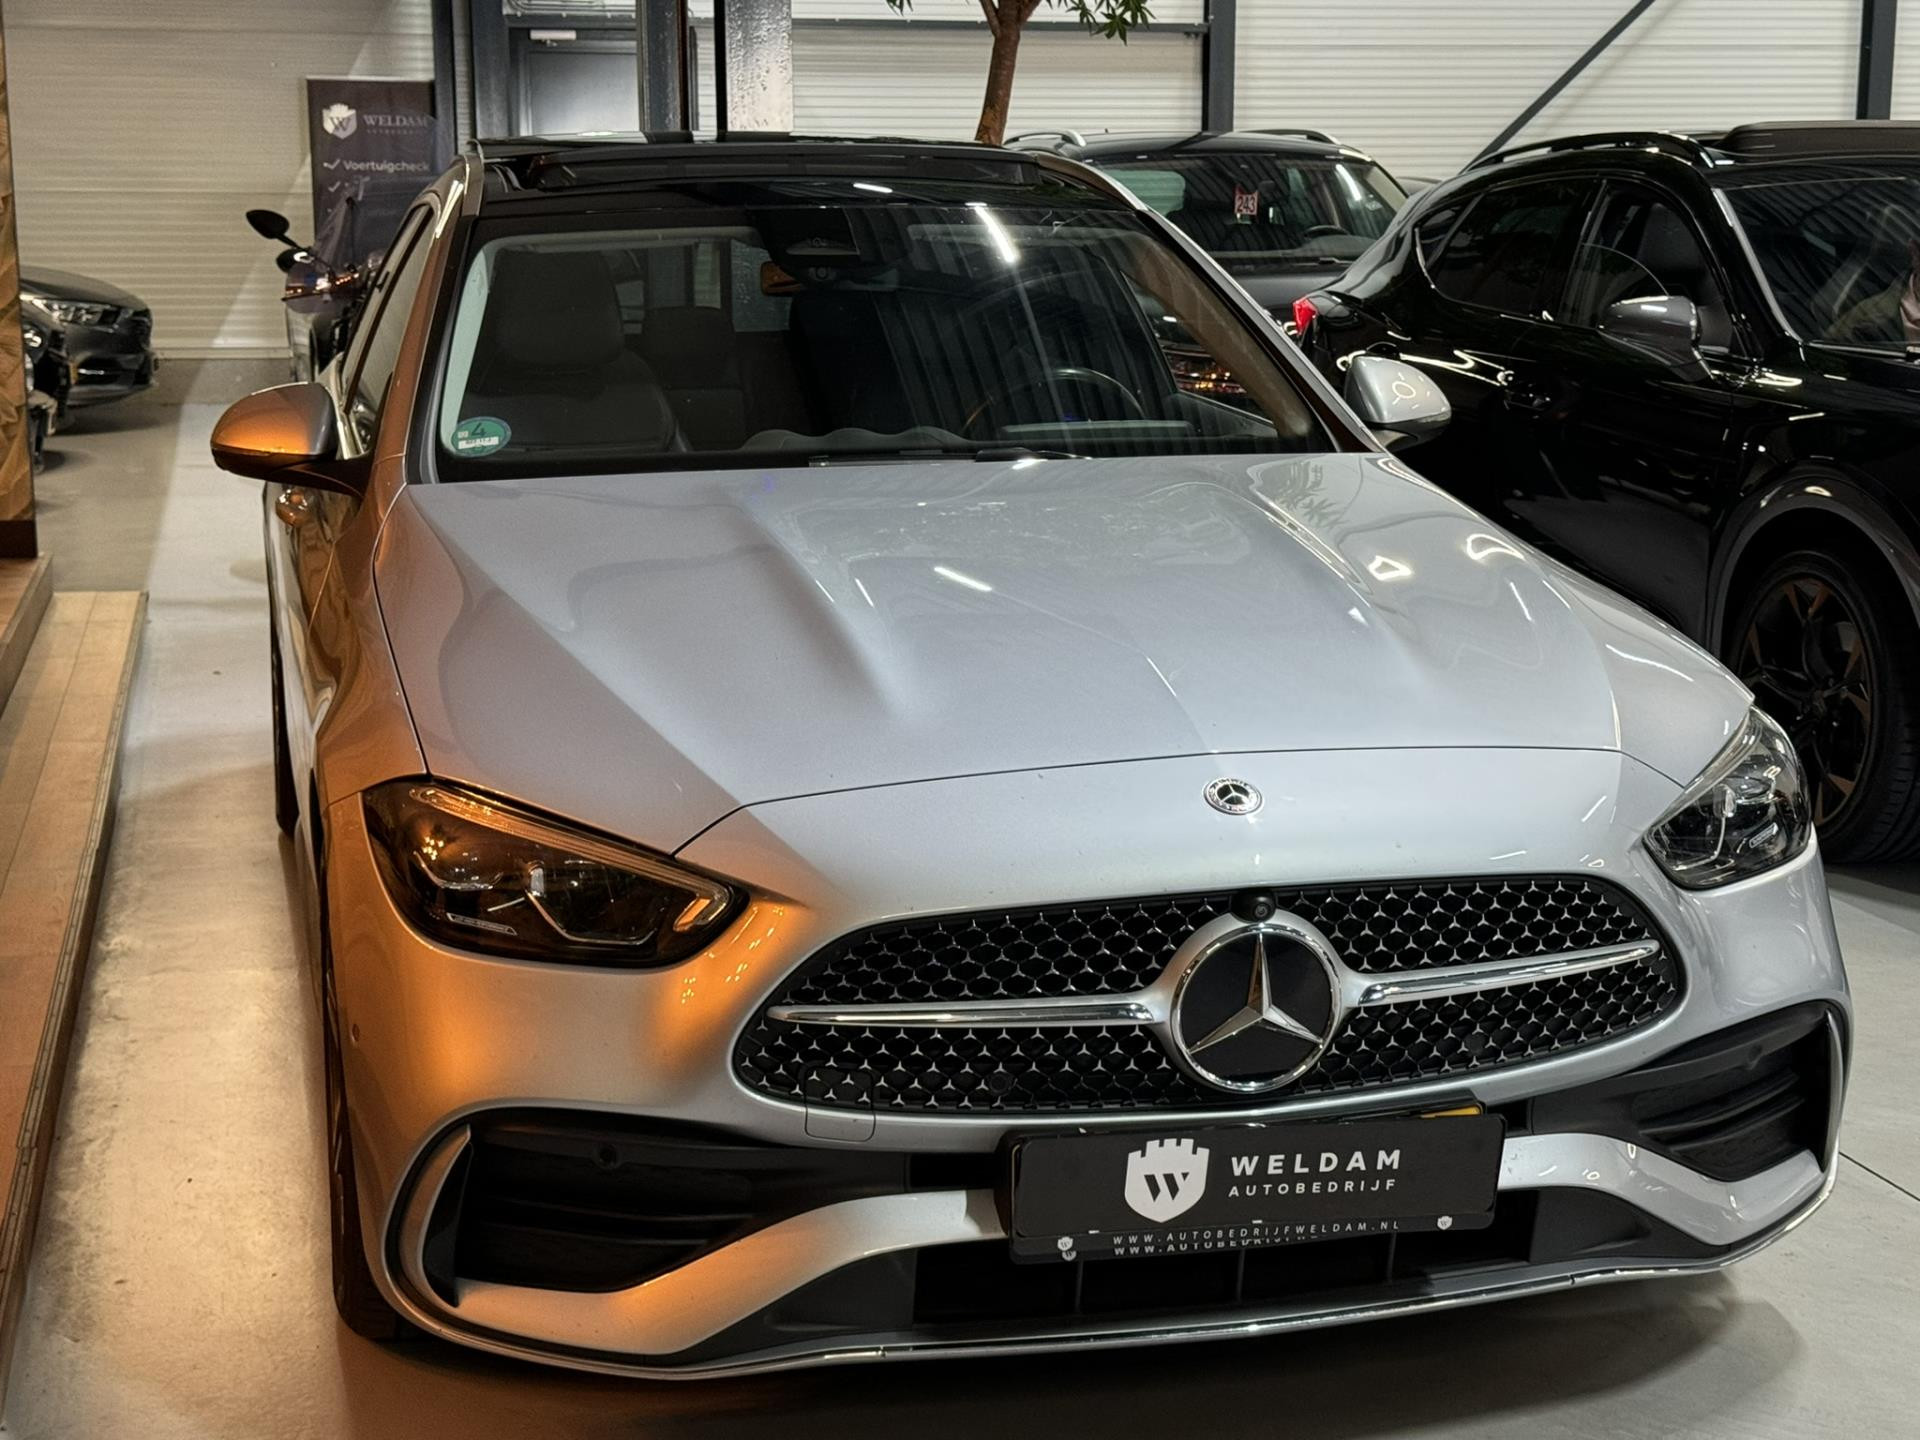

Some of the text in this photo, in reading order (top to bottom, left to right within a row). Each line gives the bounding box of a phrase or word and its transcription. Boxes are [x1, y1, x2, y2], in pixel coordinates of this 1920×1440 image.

[363, 114, 429, 127] WELDAM
[343, 160, 430, 174] Voertuigcheck
[1237, 196, 1256, 213] 243
[1231, 1149, 1401, 1177] WELDAM
[1143, 1172, 1190, 1203] W
[1228, 1179, 1396, 1198] AUTOBEDRIJF
[1113, 1220, 1399, 1245] WWW.AUTOBEDRIJFWELDAM.NL
